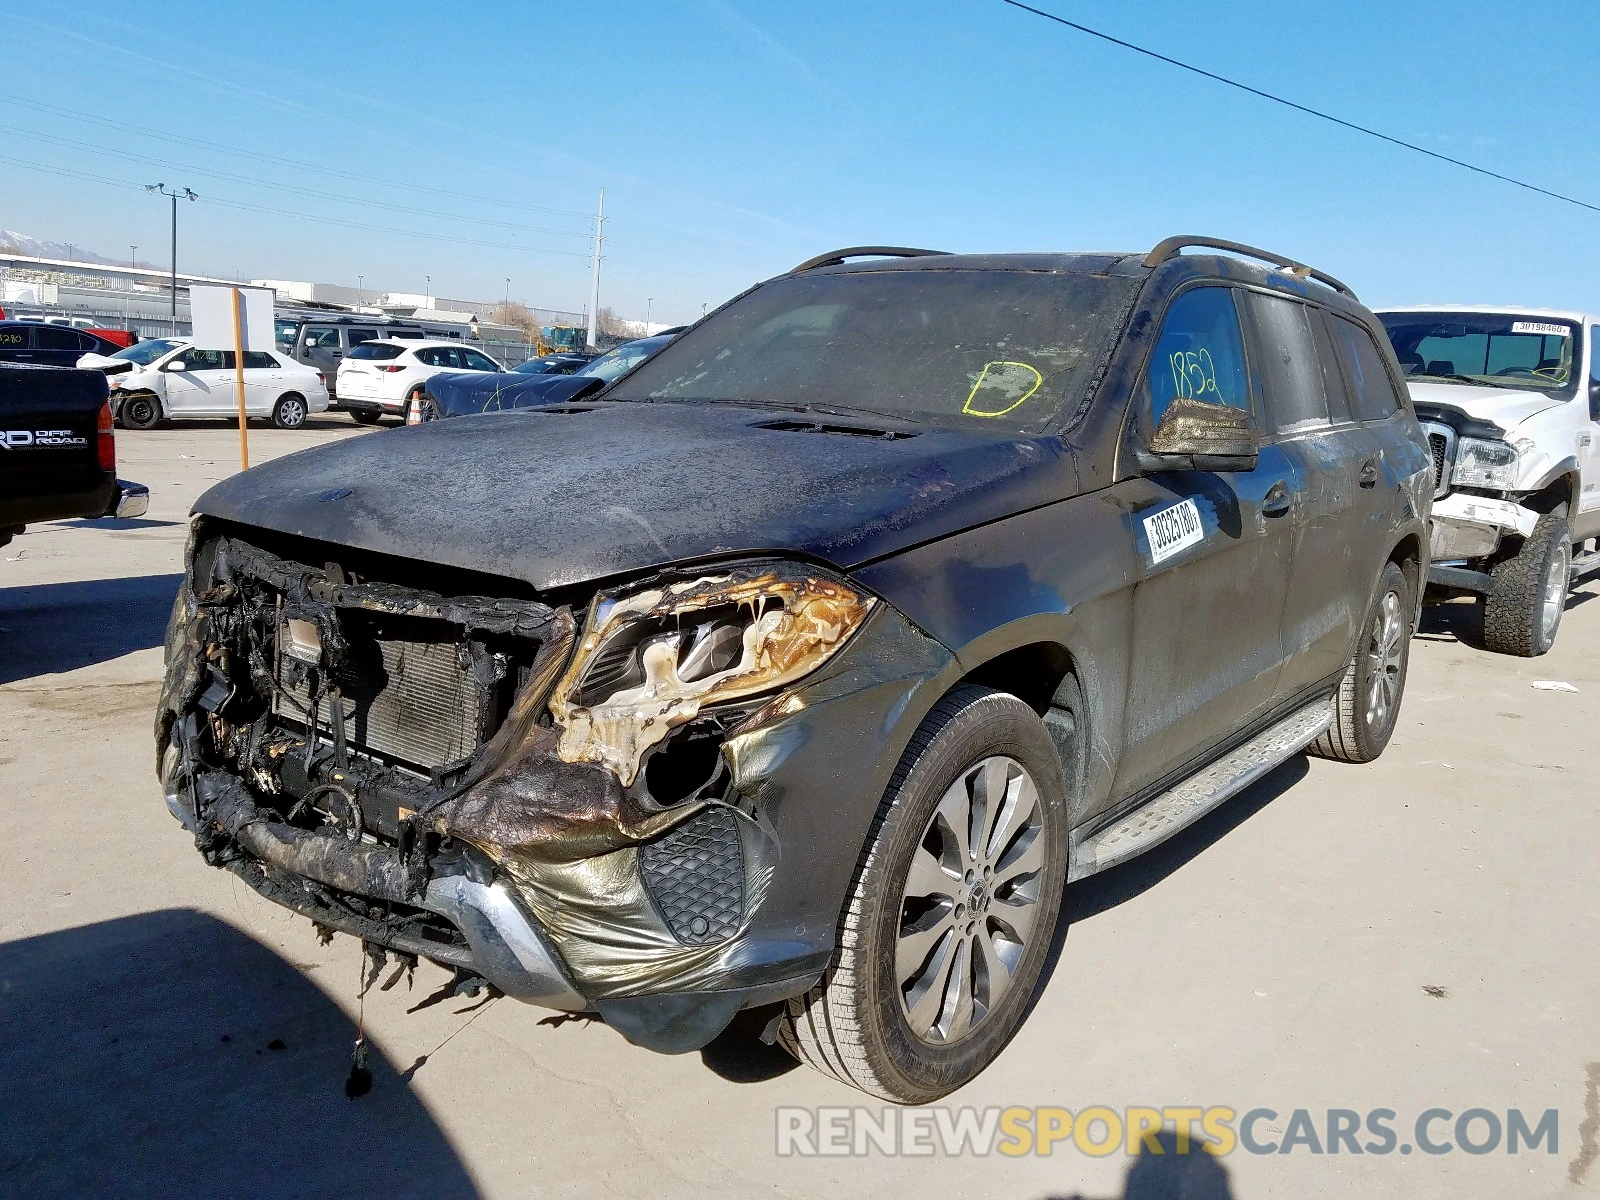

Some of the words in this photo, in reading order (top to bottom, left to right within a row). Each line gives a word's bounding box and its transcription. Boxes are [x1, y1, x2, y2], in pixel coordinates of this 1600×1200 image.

[1520, 322, 1563, 333] 30198460
[35, 437, 88, 445] ROAD
[1151, 502, 1195, 549] 30325180
